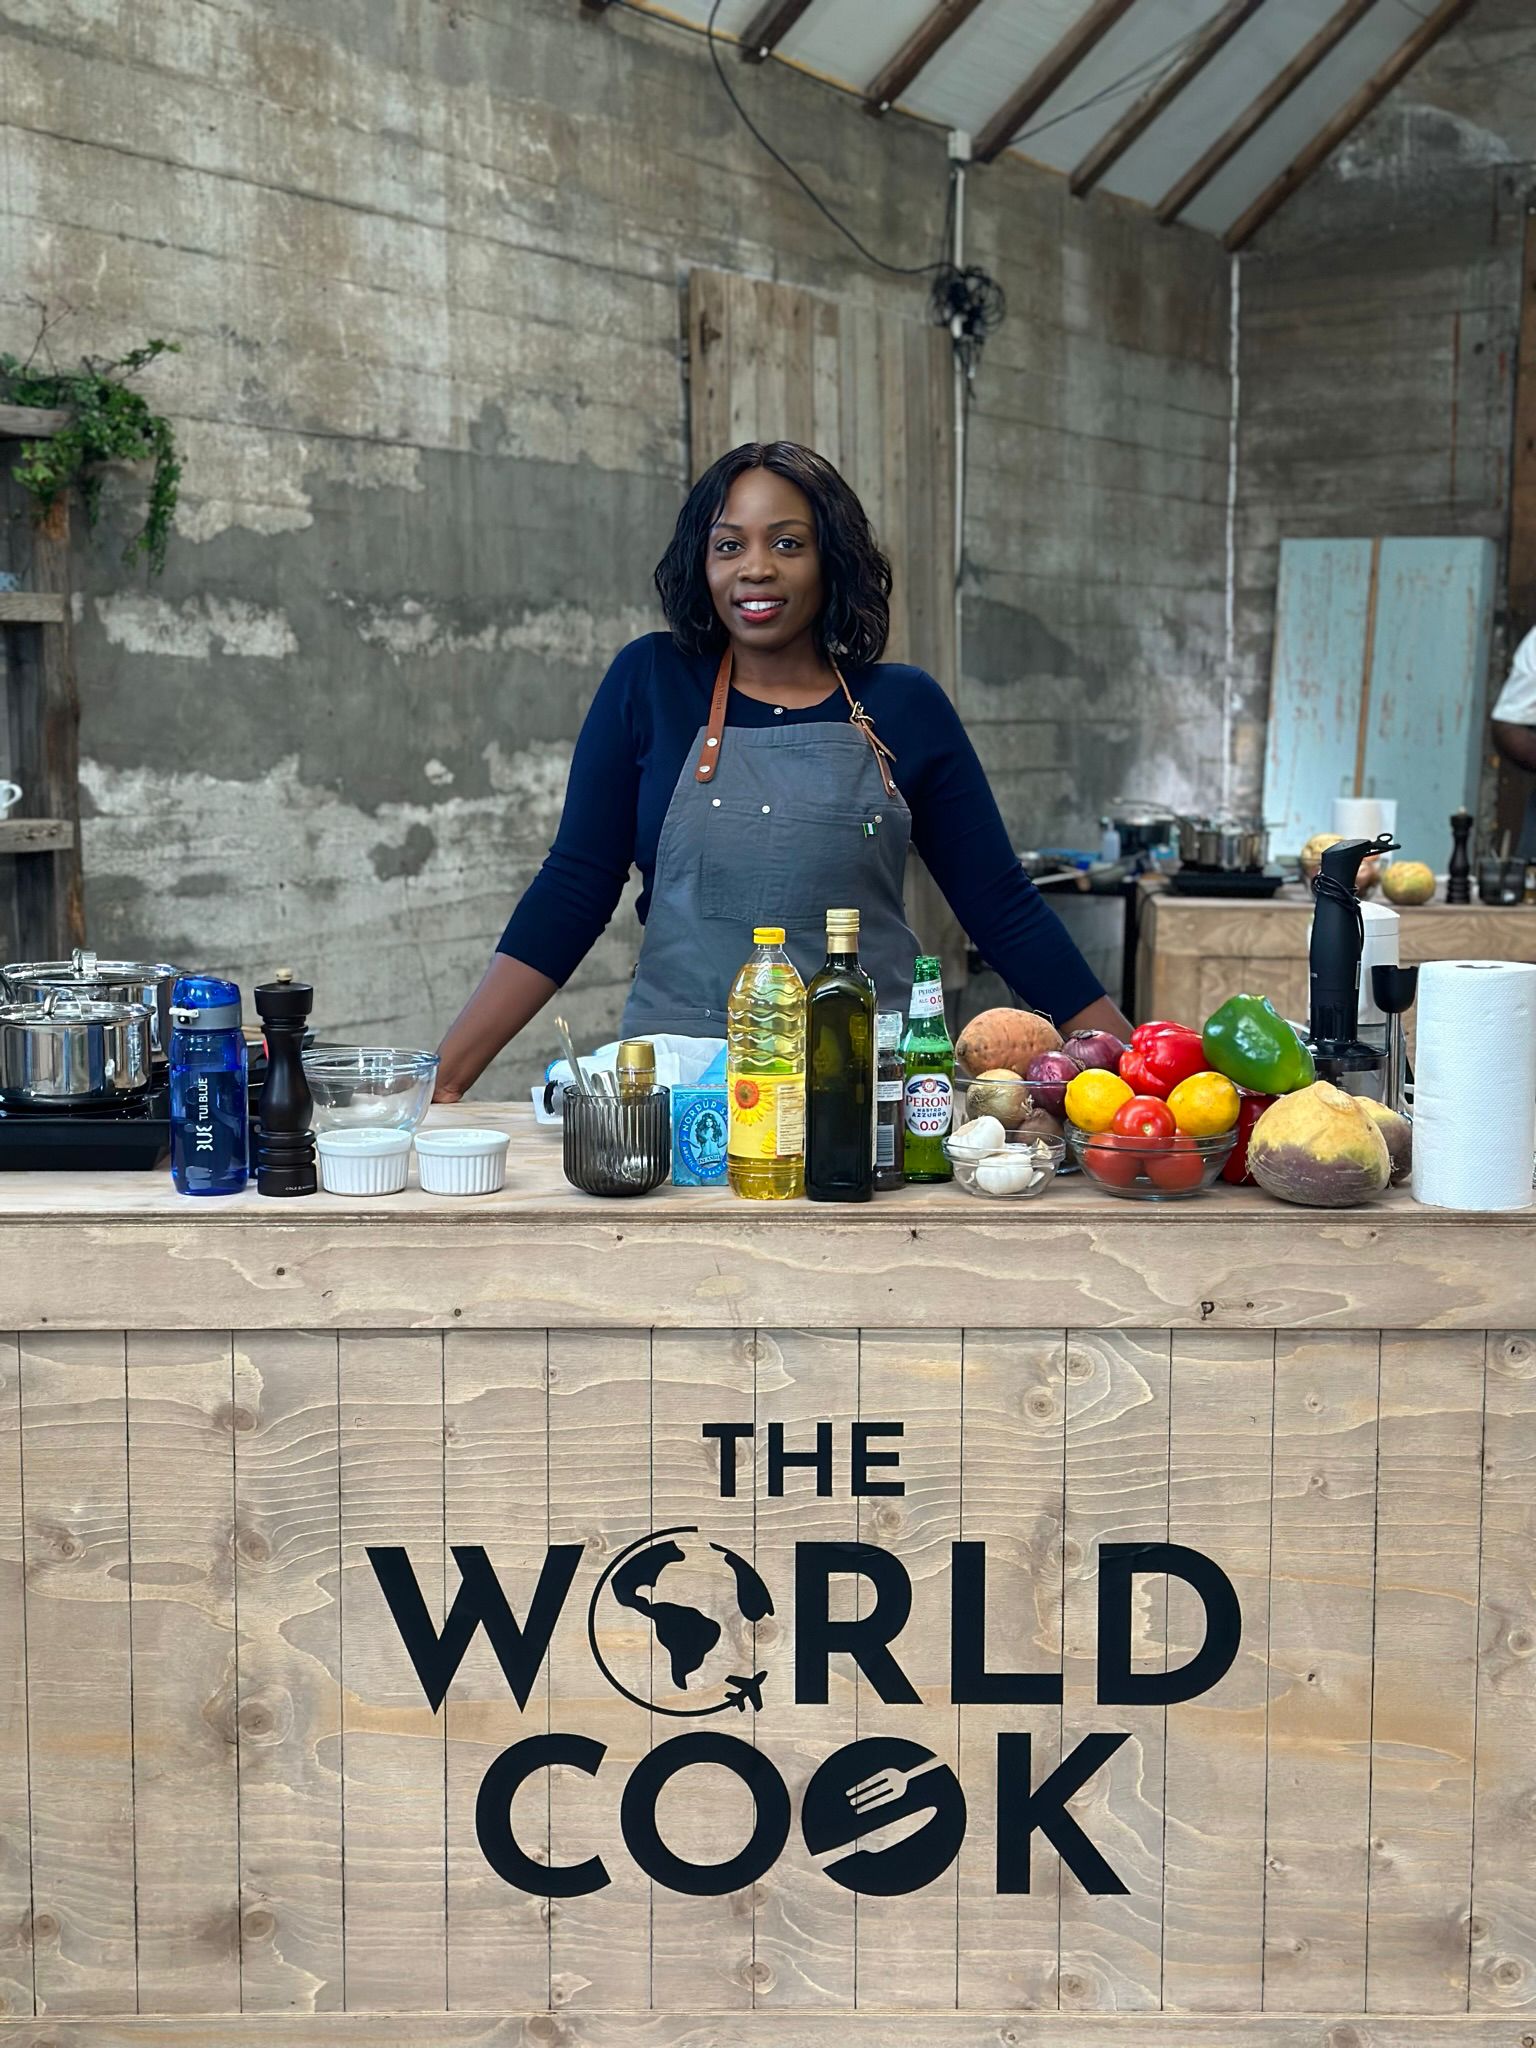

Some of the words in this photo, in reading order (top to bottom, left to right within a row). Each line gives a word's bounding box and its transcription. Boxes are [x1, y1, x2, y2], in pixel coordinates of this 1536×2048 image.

[198, 1077, 208, 1103] BLUE
[199, 1105, 209, 1121] TUI
[905, 1095, 951, 1108] PERONI
[703, 1422, 905, 1498] THE
[365, 1527, 1242, 1718] WORLD
[476, 1732, 1133, 1899] COOK
